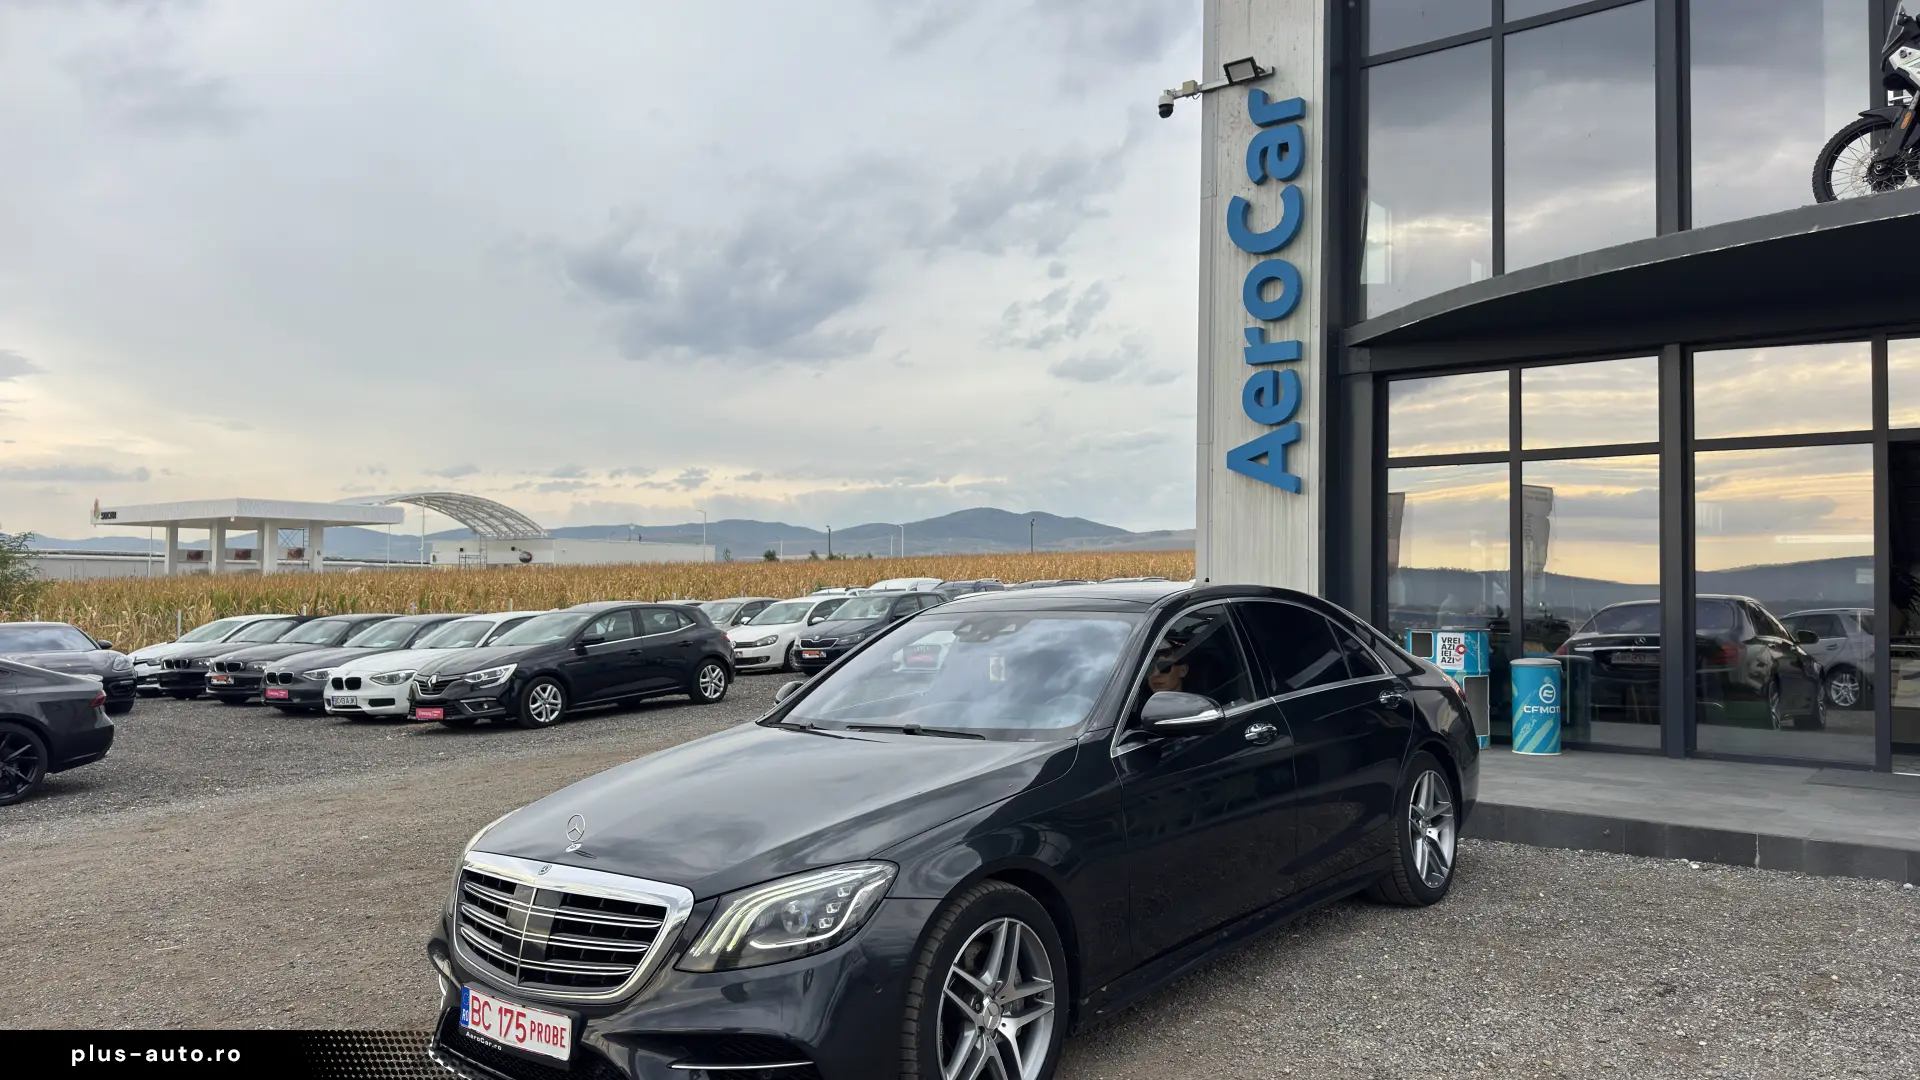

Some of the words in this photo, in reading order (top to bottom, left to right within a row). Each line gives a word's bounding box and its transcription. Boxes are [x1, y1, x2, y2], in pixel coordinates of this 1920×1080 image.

[1227, 88, 1306, 494] AeroCar
[1441, 636, 1461, 645] VREI
[1441, 643, 1455, 651] AZI
[1441, 656, 1455, 664] AZI
[1523, 705, 1561, 714] CFMOT
[471, 994, 492, 1031] BC
[498, 1006, 527, 1043] 175
[530, 1020, 566, 1048] PROBE
